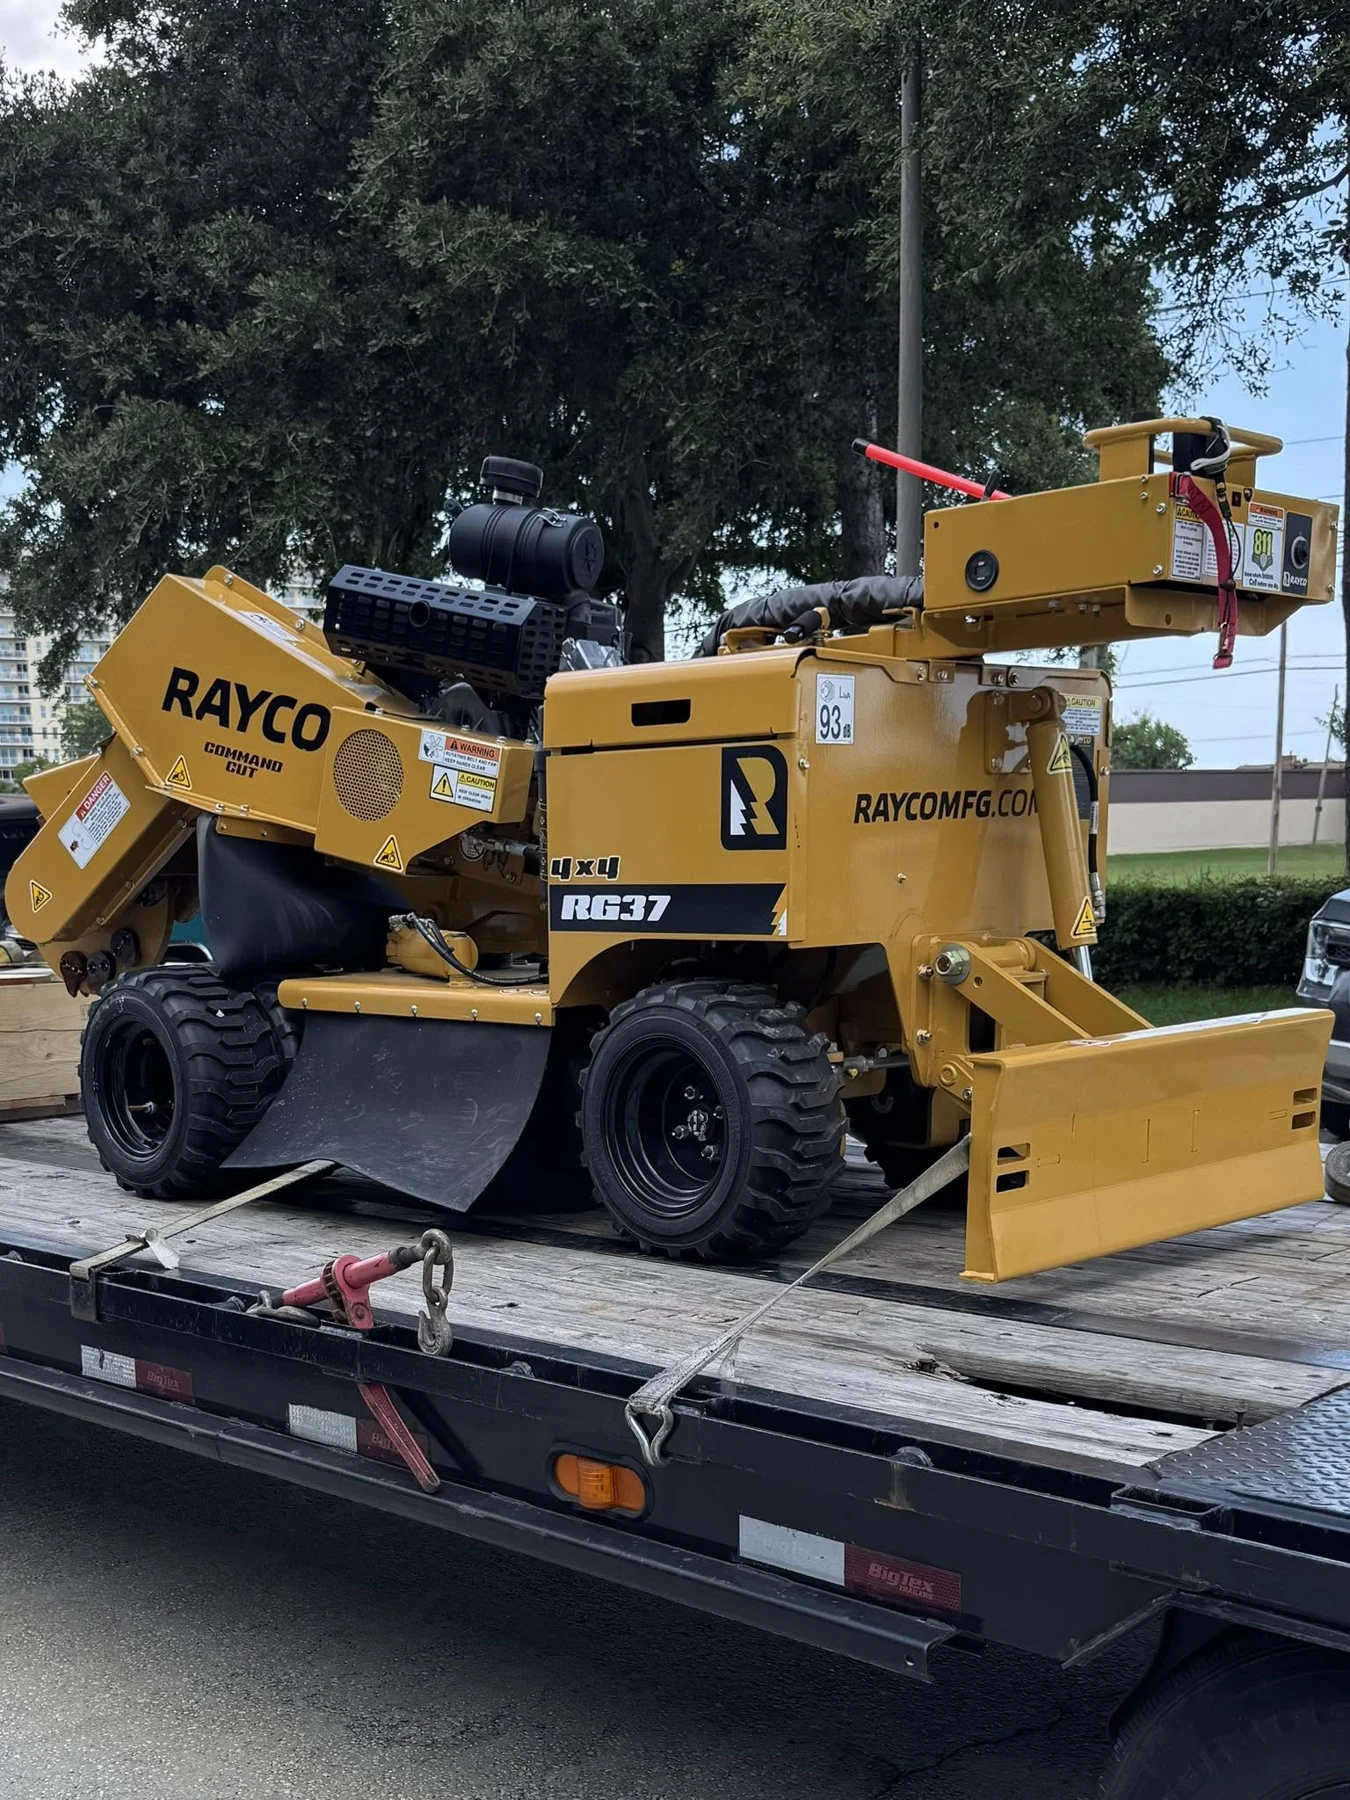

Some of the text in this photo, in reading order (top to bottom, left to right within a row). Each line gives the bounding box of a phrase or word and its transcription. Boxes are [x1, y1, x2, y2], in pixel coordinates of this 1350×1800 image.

[1254, 528, 1273, 556] 811
[162, 666, 331, 751] RAYCO
[820, 704, 841, 739] 93
[203, 741, 283, 773] COMMAND
[460, 743, 495, 758] WARNING
[225, 760, 258, 779] CUT
[466, 776, 494, 789] CAUTION
[84, 775, 110, 810] DANGER
[550, 856, 622, 882] 4x4
[561, 894, 671, 921] RG37
[867, 1562, 935, 1594] BigTex
